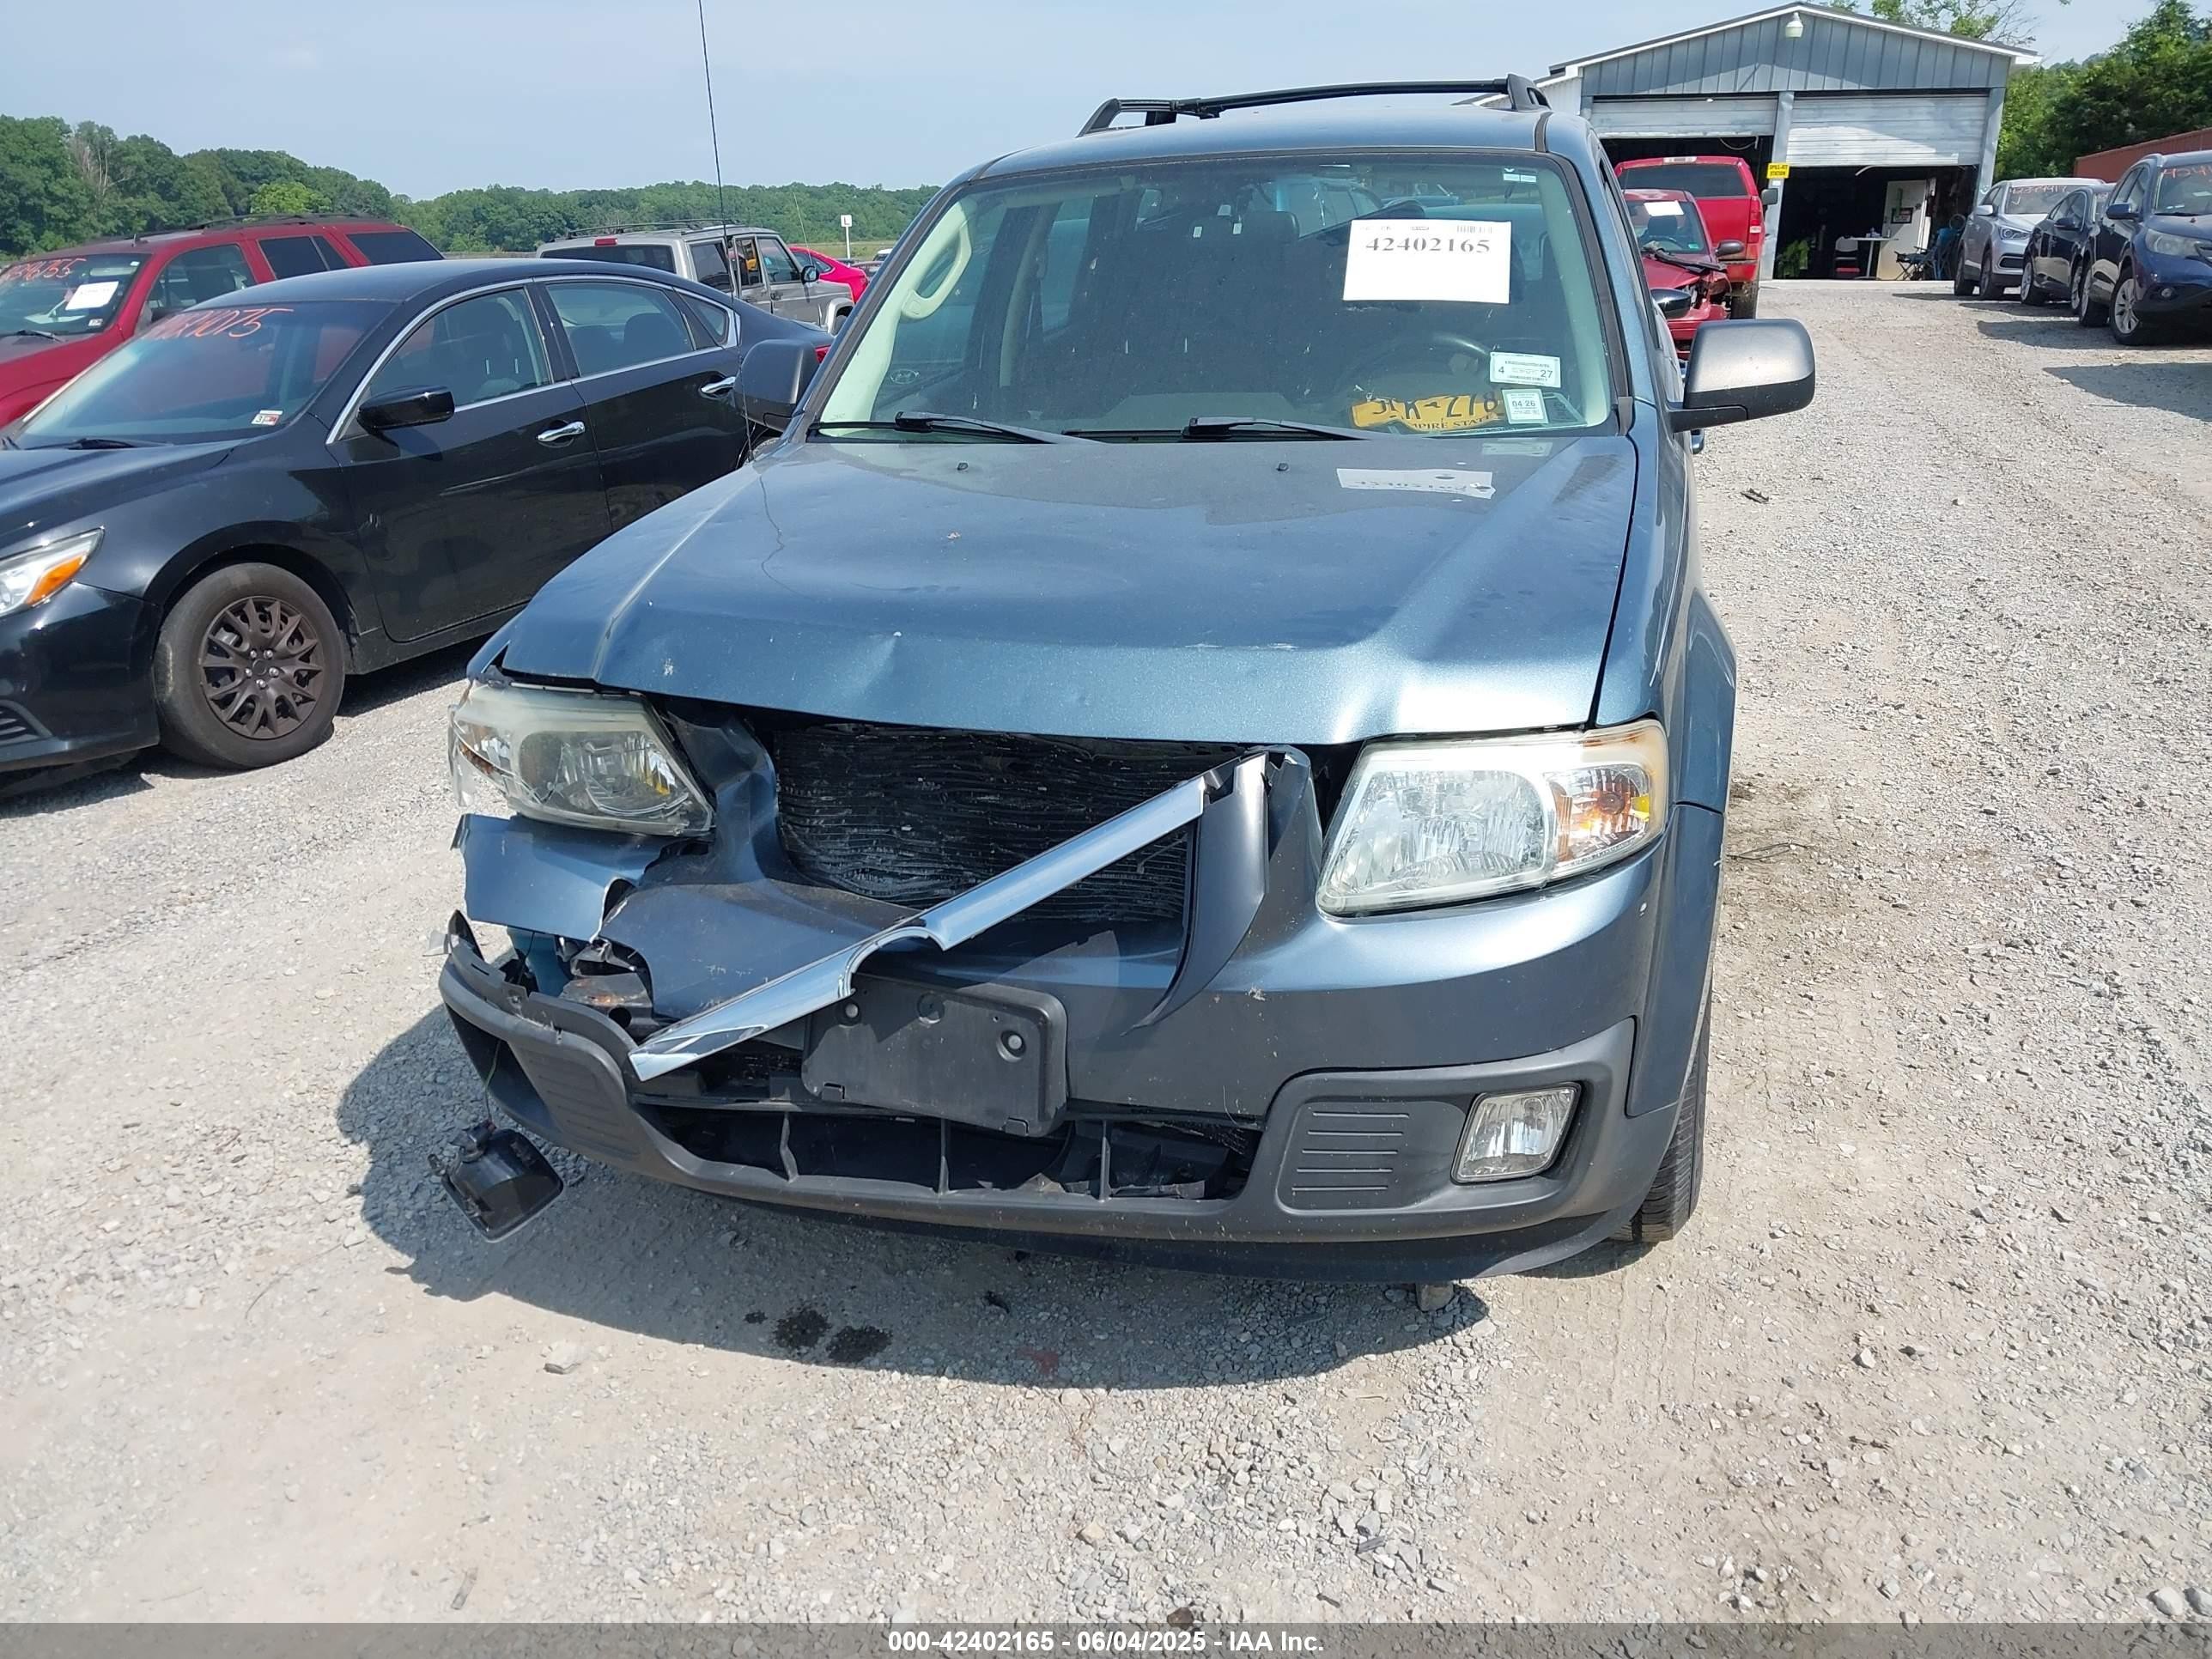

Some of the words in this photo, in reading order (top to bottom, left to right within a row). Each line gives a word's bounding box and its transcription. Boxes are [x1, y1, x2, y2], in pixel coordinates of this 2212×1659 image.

[1365, 237, 1491, 253] 42402165
[1498, 366, 1505, 374] 4
[1540, 369, 1553, 379] 27
